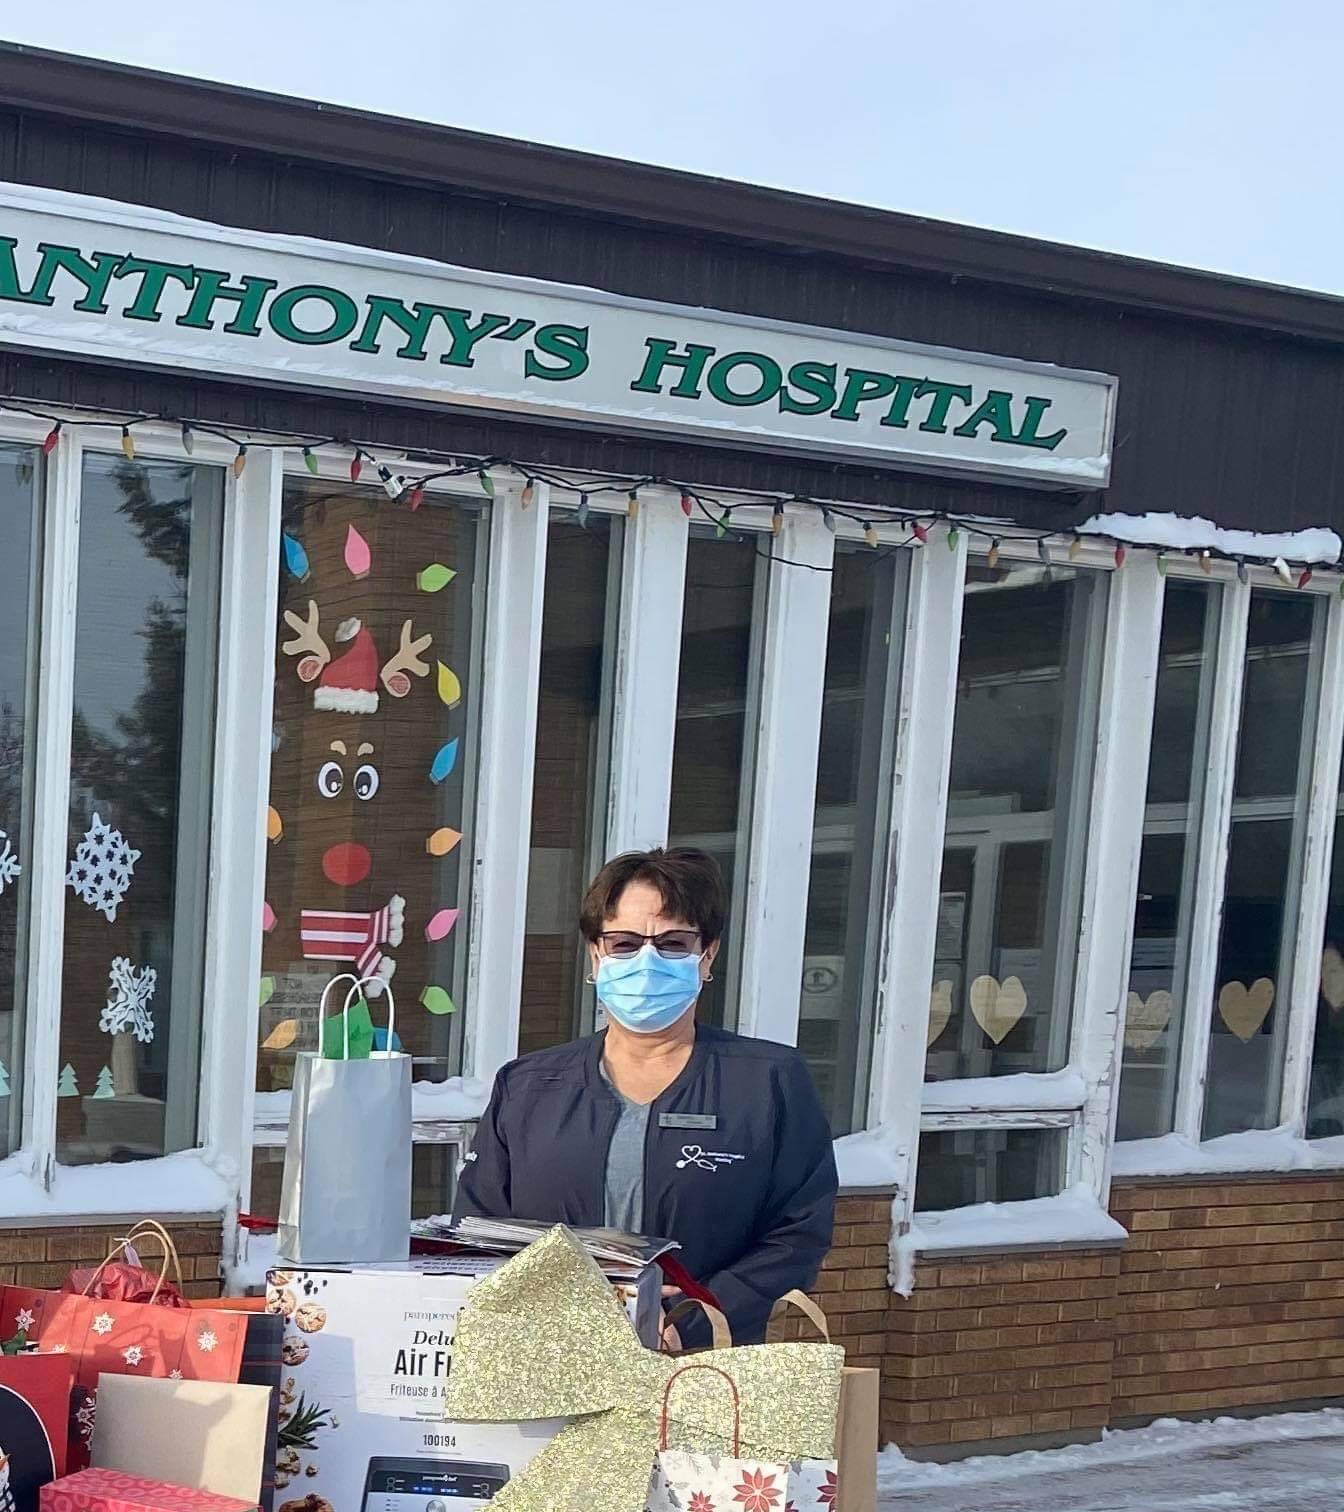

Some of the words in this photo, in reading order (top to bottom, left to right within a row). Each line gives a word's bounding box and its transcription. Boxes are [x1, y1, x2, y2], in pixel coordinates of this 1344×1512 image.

[629, 336, 1069, 452] HOSPITAL
[394, 1349, 427, 1376] Air
[390, 1383, 429, 1397] Friteuse
[423, 1434, 456, 1447] 100194
